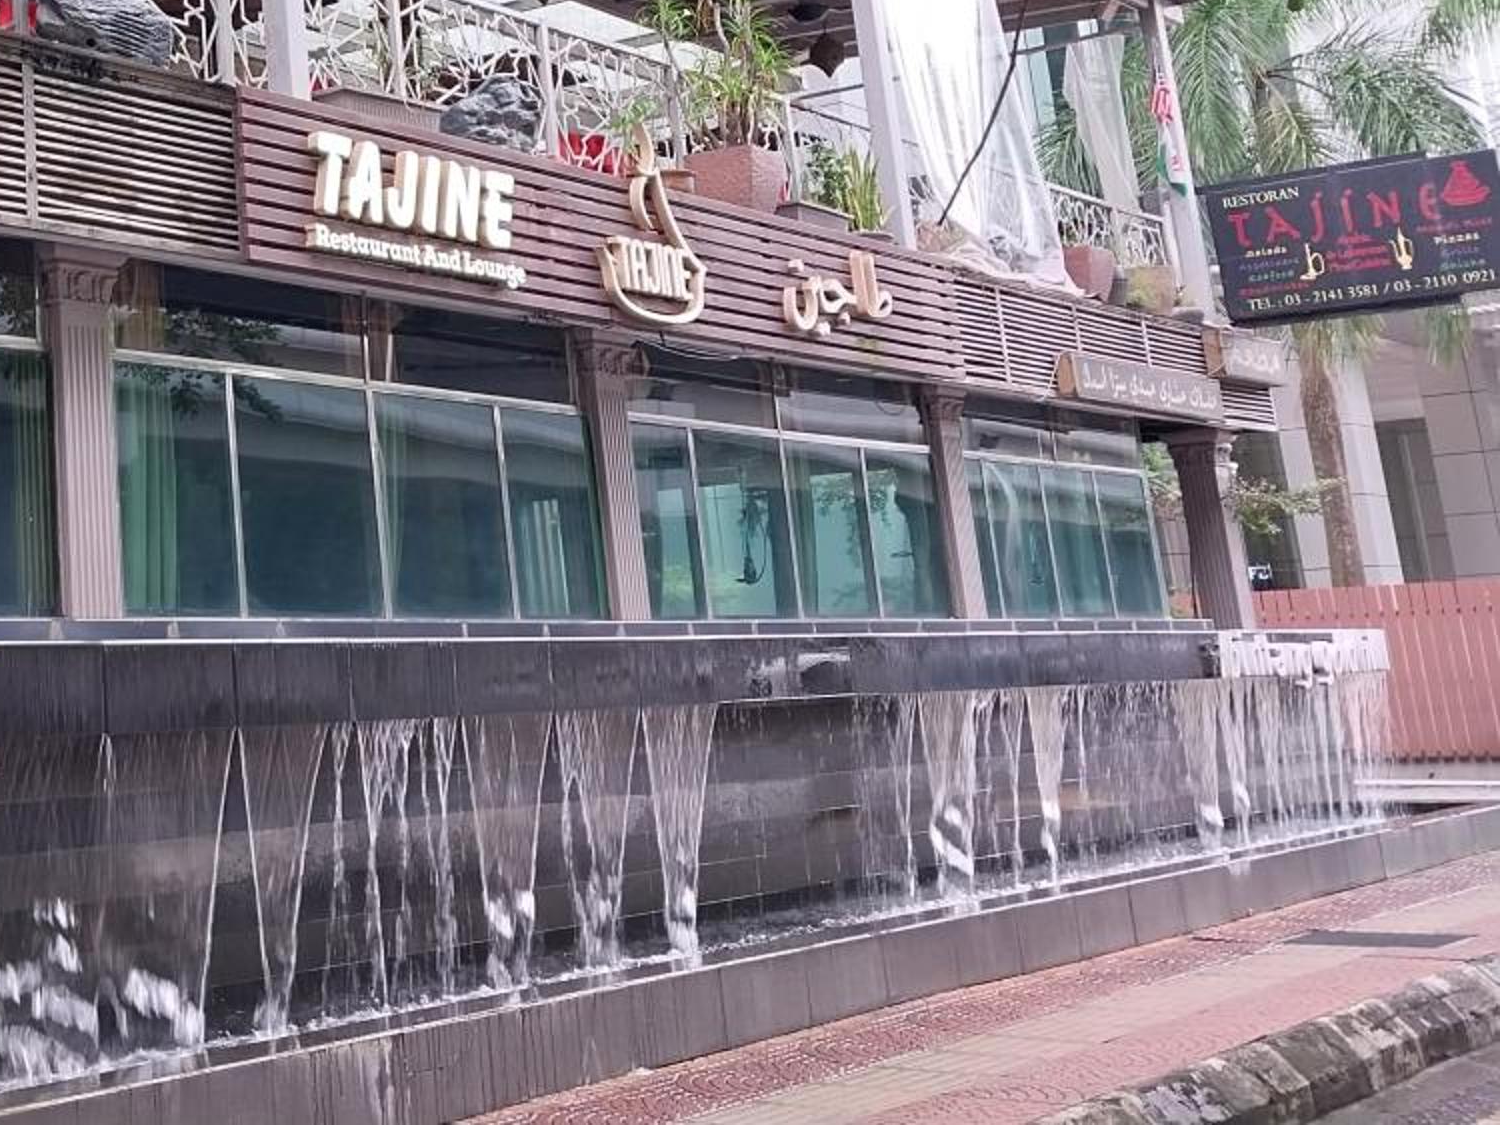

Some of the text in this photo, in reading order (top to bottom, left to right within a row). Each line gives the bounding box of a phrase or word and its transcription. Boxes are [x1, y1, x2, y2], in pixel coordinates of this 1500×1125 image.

[308, 131, 514, 249] TAJINE
[1222, 186, 1300, 209] RESTORAN
[311, 222, 527, 289] Restaurant And Lounge
[606, 235, 694, 301] TAJINE
